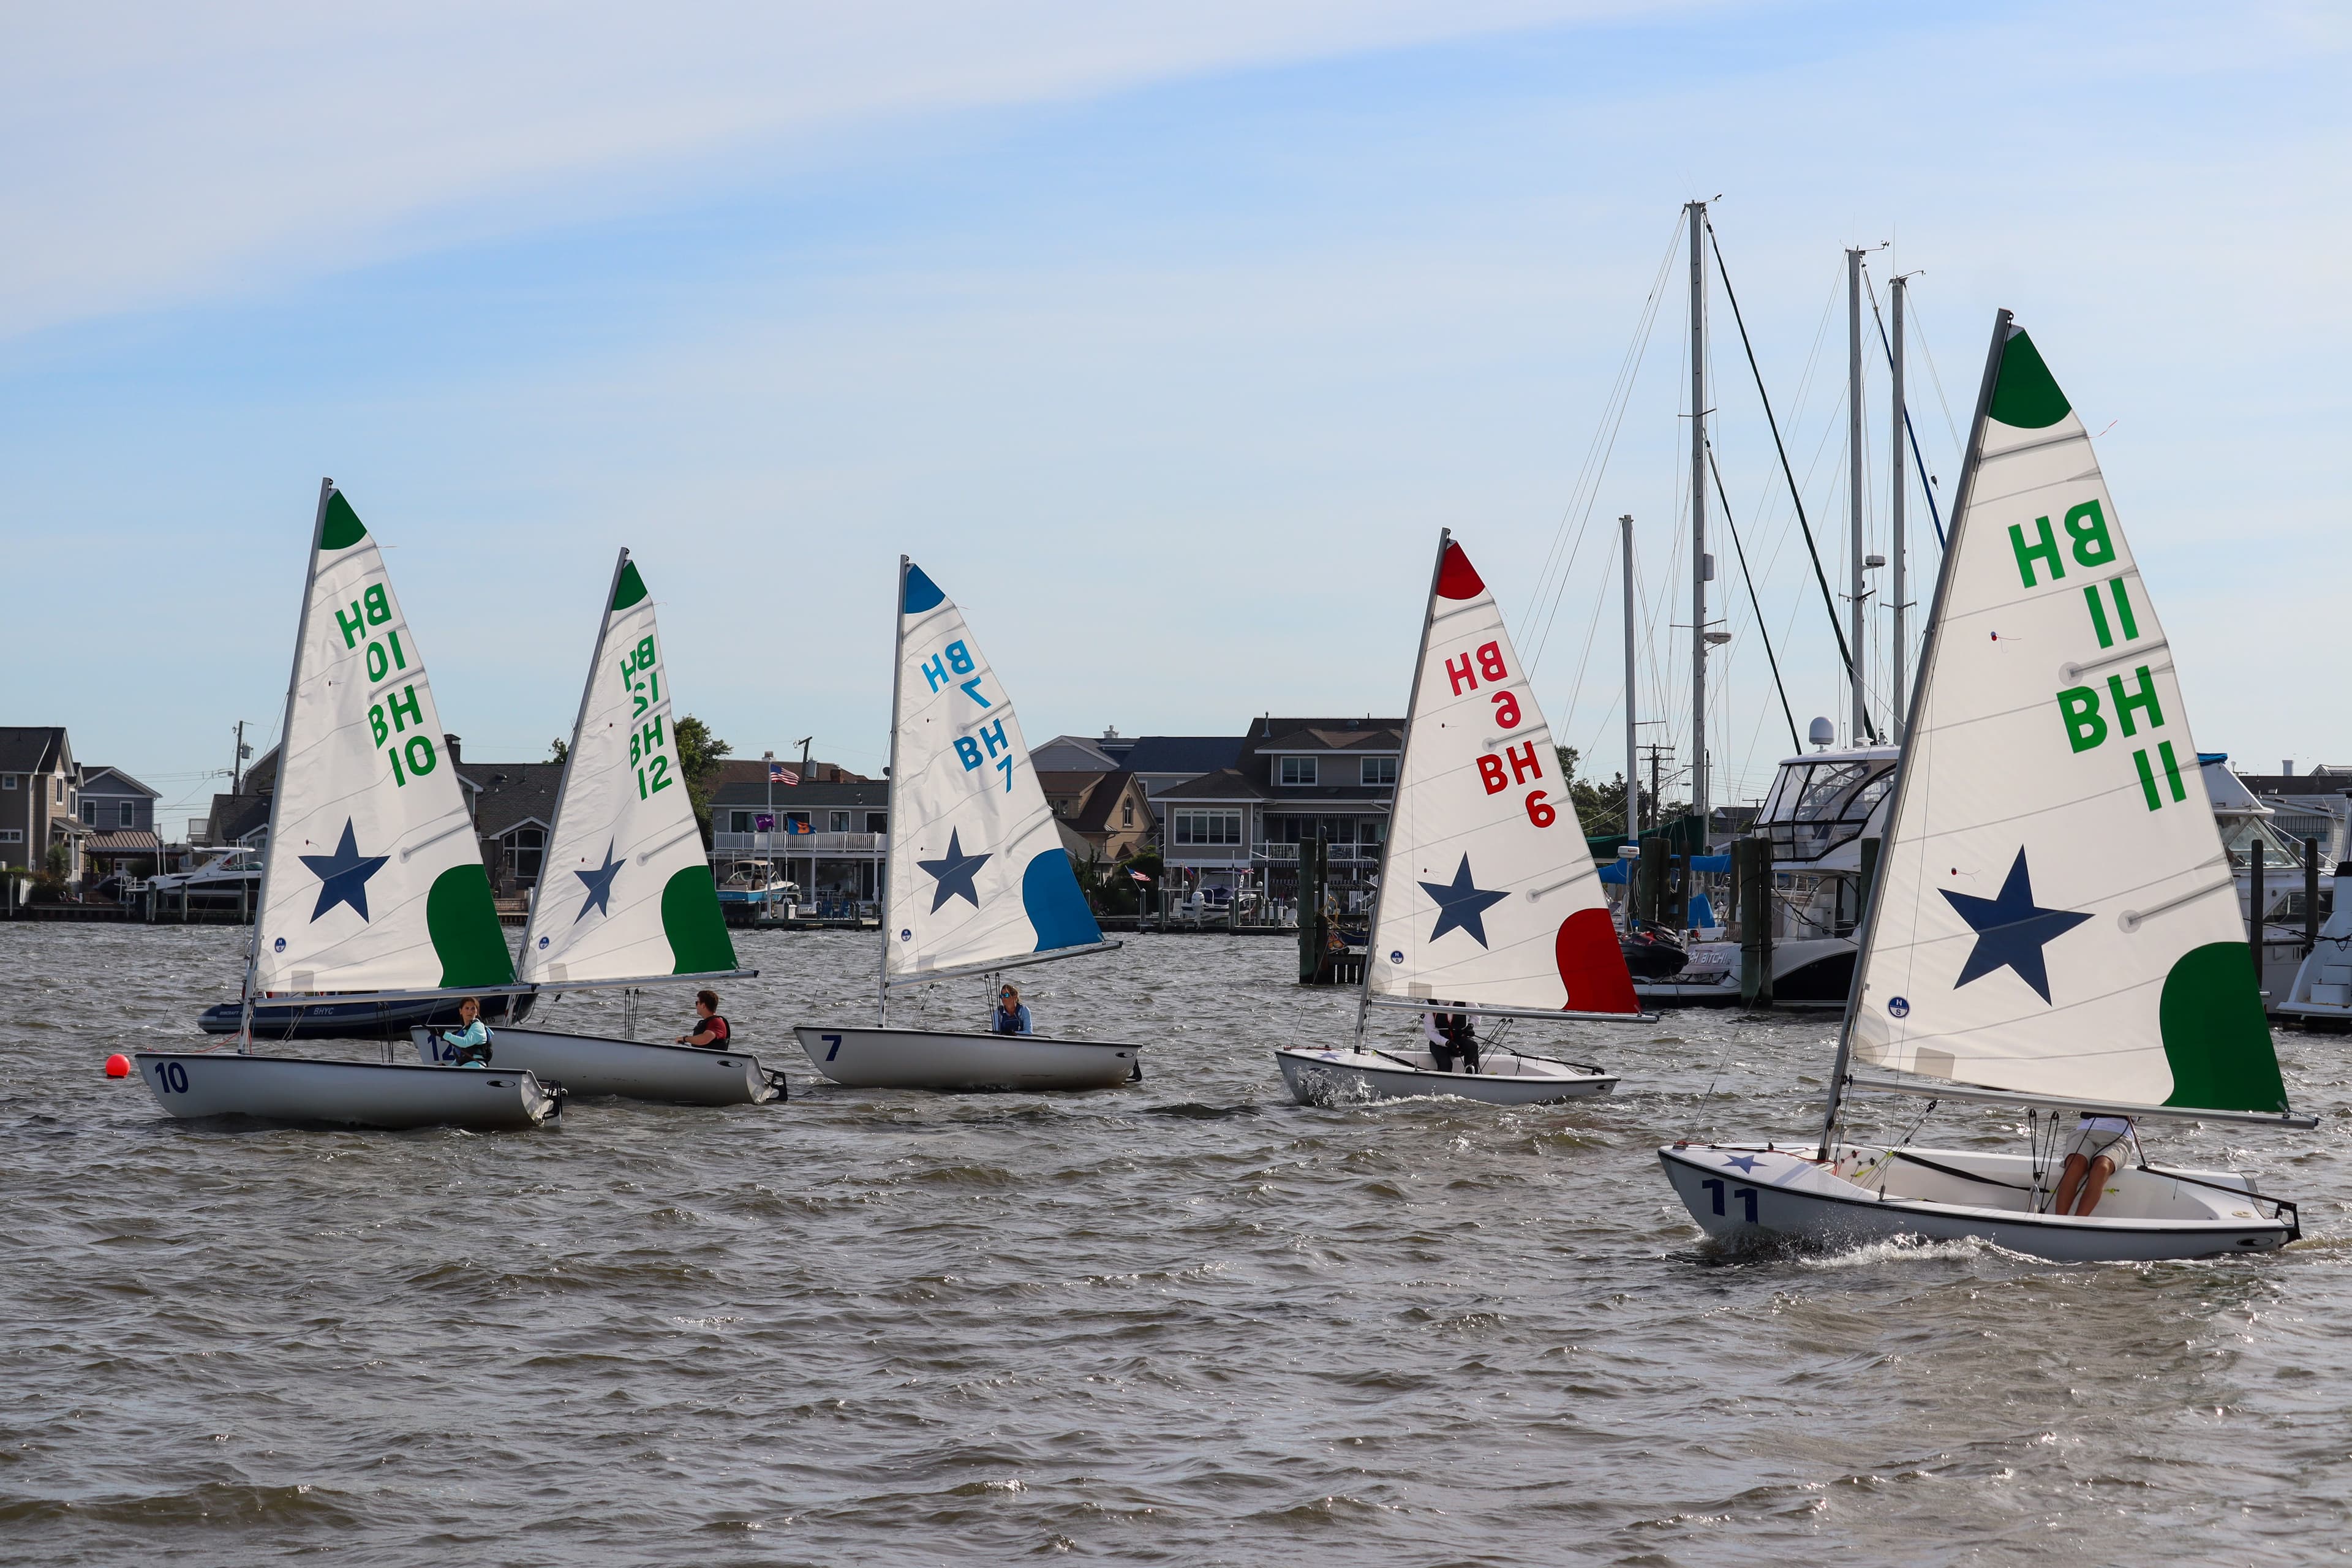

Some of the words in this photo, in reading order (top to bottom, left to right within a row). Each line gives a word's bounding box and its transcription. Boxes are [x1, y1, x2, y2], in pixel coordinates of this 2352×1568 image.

[368, 684, 424, 750] BH
[2056, 665, 2165, 754] BH
[388, 735, 437, 788] 10
[630, 714, 665, 772] BH
[952, 718, 1009, 772] BH
[1476, 740, 1544, 796] BH
[638, 755, 673, 801] 12
[996, 754, 1012, 794] 7
[2132, 739, 2187, 812] 11
[1525, 790, 1556, 829] 6
[1700, 952, 1727, 964] BITCH!
[821, 1035, 842, 1061] 7
[154, 1061, 189, 1095] 10
[1701, 1178, 1759, 1226] 11
